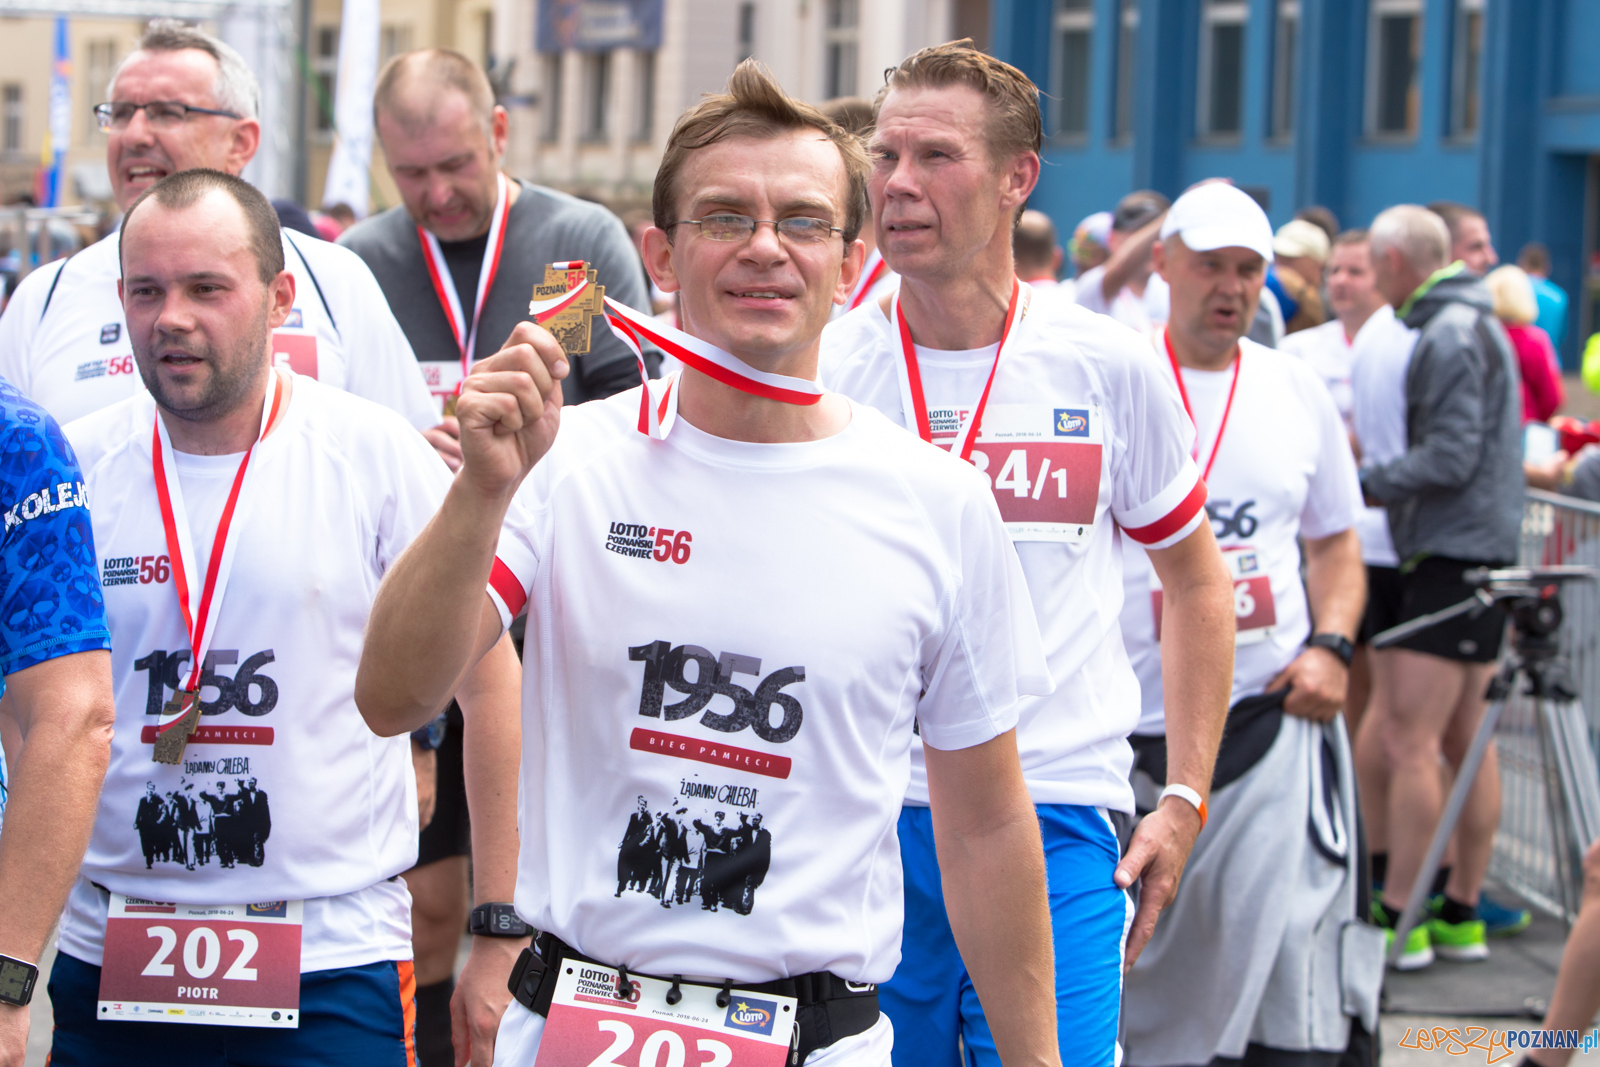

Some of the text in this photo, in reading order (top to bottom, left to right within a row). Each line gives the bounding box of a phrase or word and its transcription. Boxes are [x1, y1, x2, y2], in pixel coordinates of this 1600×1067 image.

[535, 282, 567, 296] POZNAŃ
[929, 410, 954, 419] LOTTO
[1063, 418, 1081, 429] LOTTO
[609, 521, 648, 539] LOTTO
[607, 534, 654, 550] POZNAŃSKI
[648, 526, 693, 565] '56
[605, 542, 653, 560] CZERWIEC
[104, 557, 133, 570] LOTTO
[134, 554, 171, 585] '56
[103, 567, 139, 578] POZNAŃSKI
[102, 576, 138, 587] CZERWIEC
[628, 639, 806, 744] 1956
[649, 737, 771, 769] BIEG PAMIĘCI
[216, 757, 250, 775] CHLEBA
[717, 784, 758, 809] CHLEBA
[140, 925, 260, 981] 202
[580, 968, 610, 983] LOTTO
[576, 985, 613, 998] CZERWIEC
[577, 978, 614, 992] POZNAŃSKI
[177, 986, 219, 1000] PIOTR
[652, 1009, 709, 1024] Poznań, 2018-06-24
[739, 1011, 763, 1023] LOTTO
